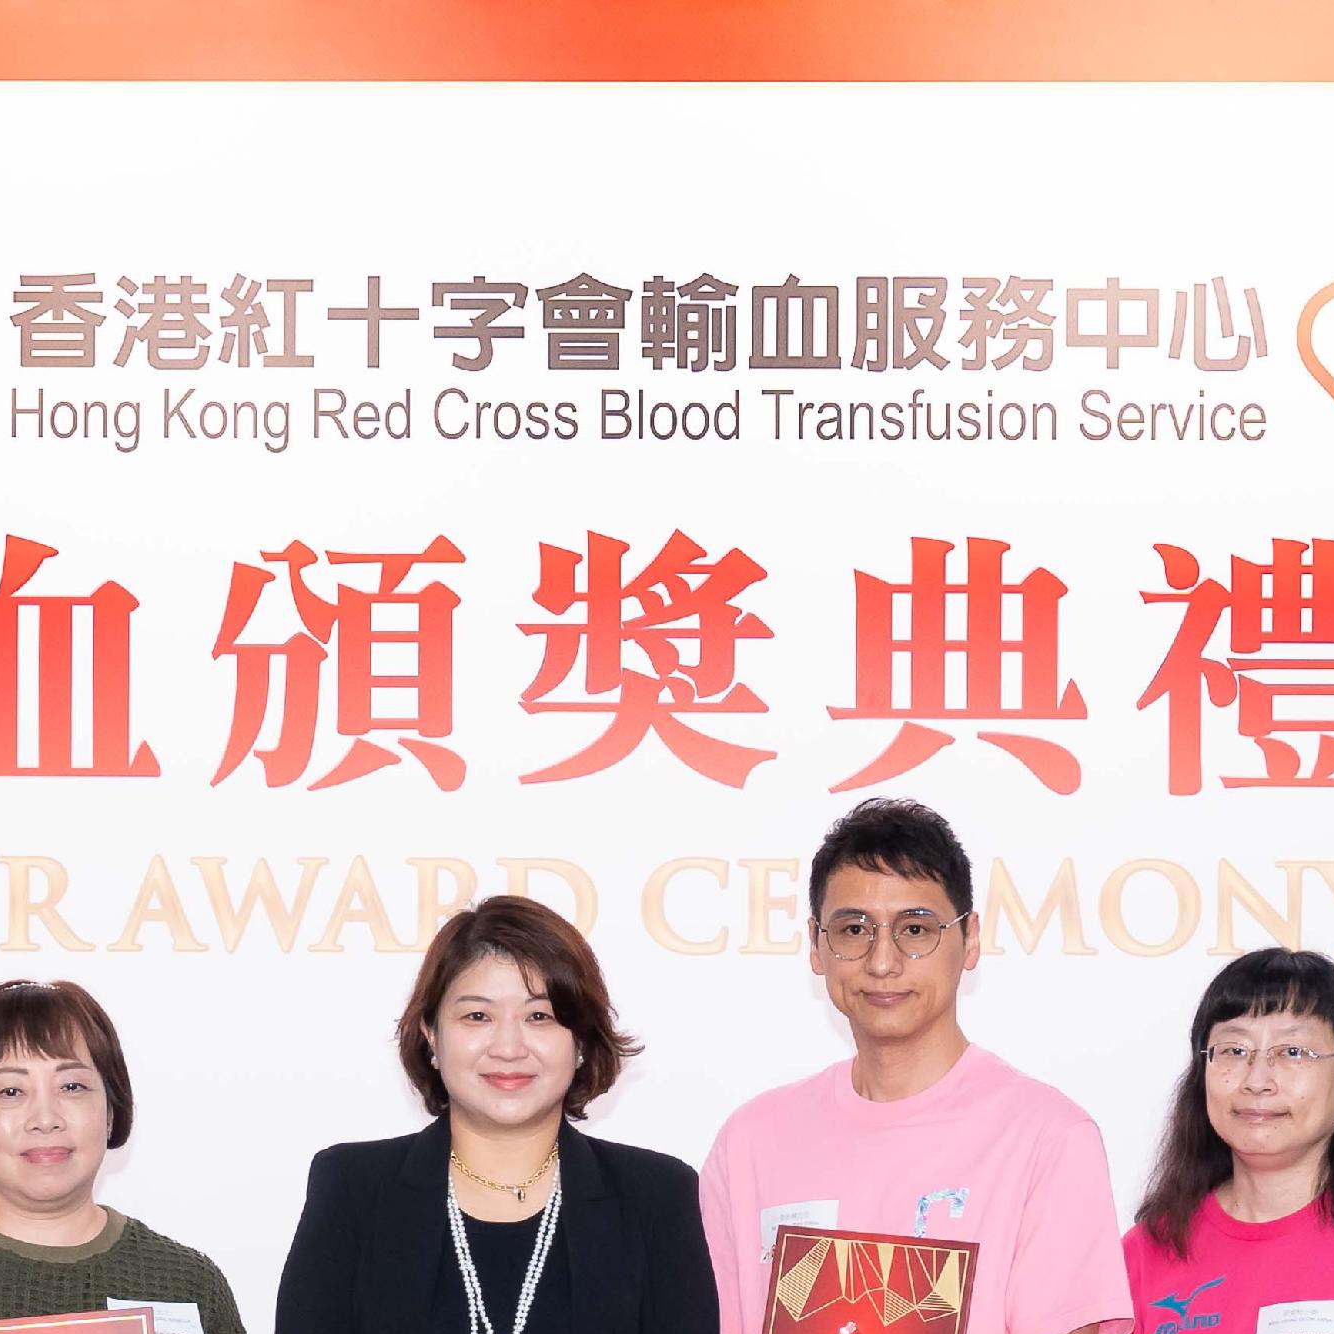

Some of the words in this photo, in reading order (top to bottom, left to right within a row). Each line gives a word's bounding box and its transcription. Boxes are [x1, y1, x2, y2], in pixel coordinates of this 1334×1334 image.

[10, 273, 1269, 373] 香港紅十字會輸血服務中心
[11, 388, 141, 454] Hong
[163, 388, 290, 454] Kong
[313, 388, 411, 440] Red
[433, 387, 579, 441] Cross
[601, 388, 740, 441] Blood
[761, 388, 1057, 441] Transfusion
[1079, 389, 1267, 441] Service
[106, 854, 600, 955] AWARD
